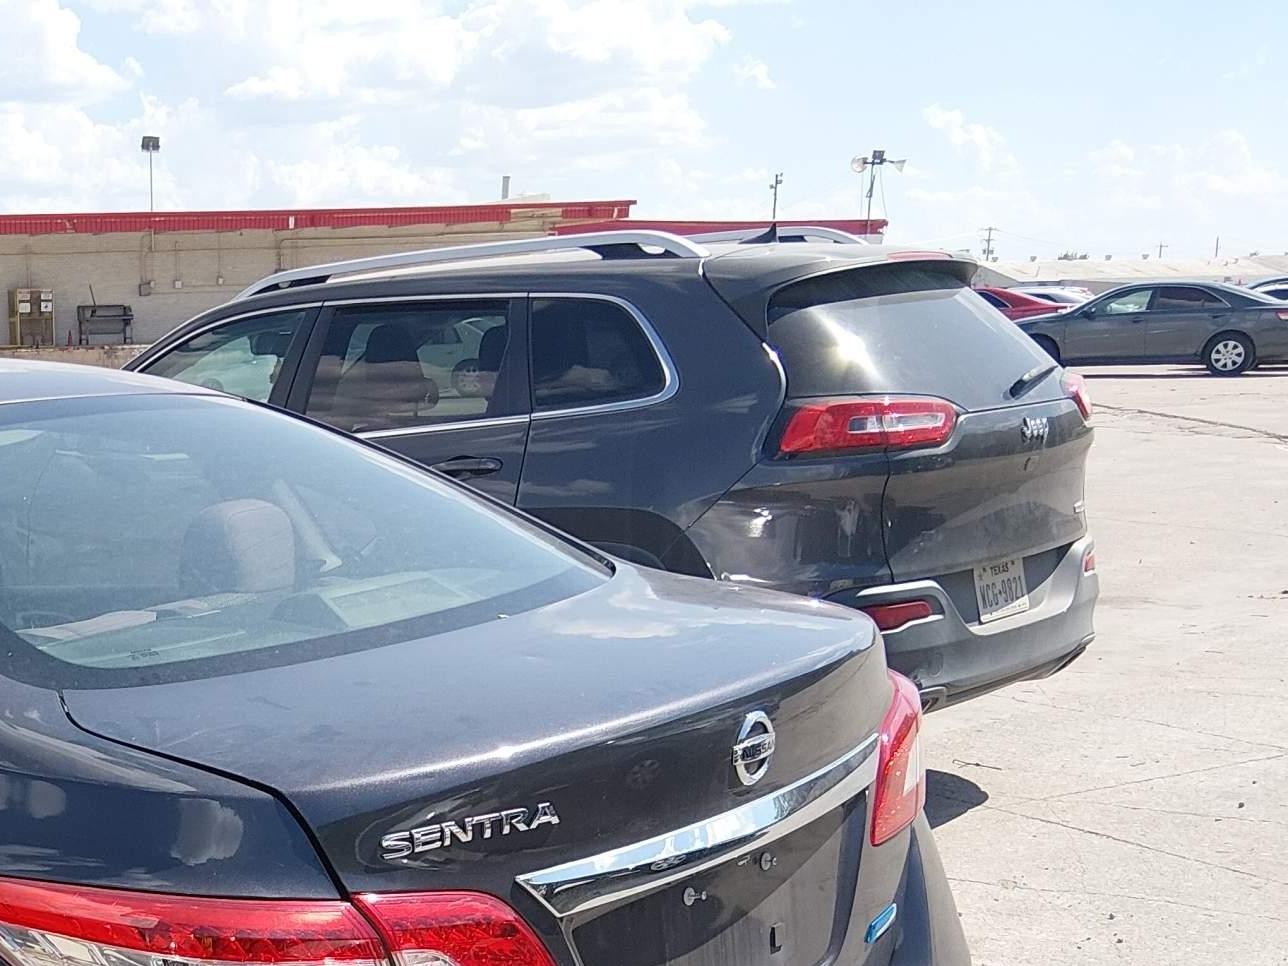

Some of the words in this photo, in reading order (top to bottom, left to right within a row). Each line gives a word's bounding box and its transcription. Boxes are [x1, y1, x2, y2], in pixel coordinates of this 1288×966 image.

[1020, 416, 1050, 444] Jeep
[990, 561, 1009, 577] TEXAS
[381, 802, 560, 860] SENTRA
